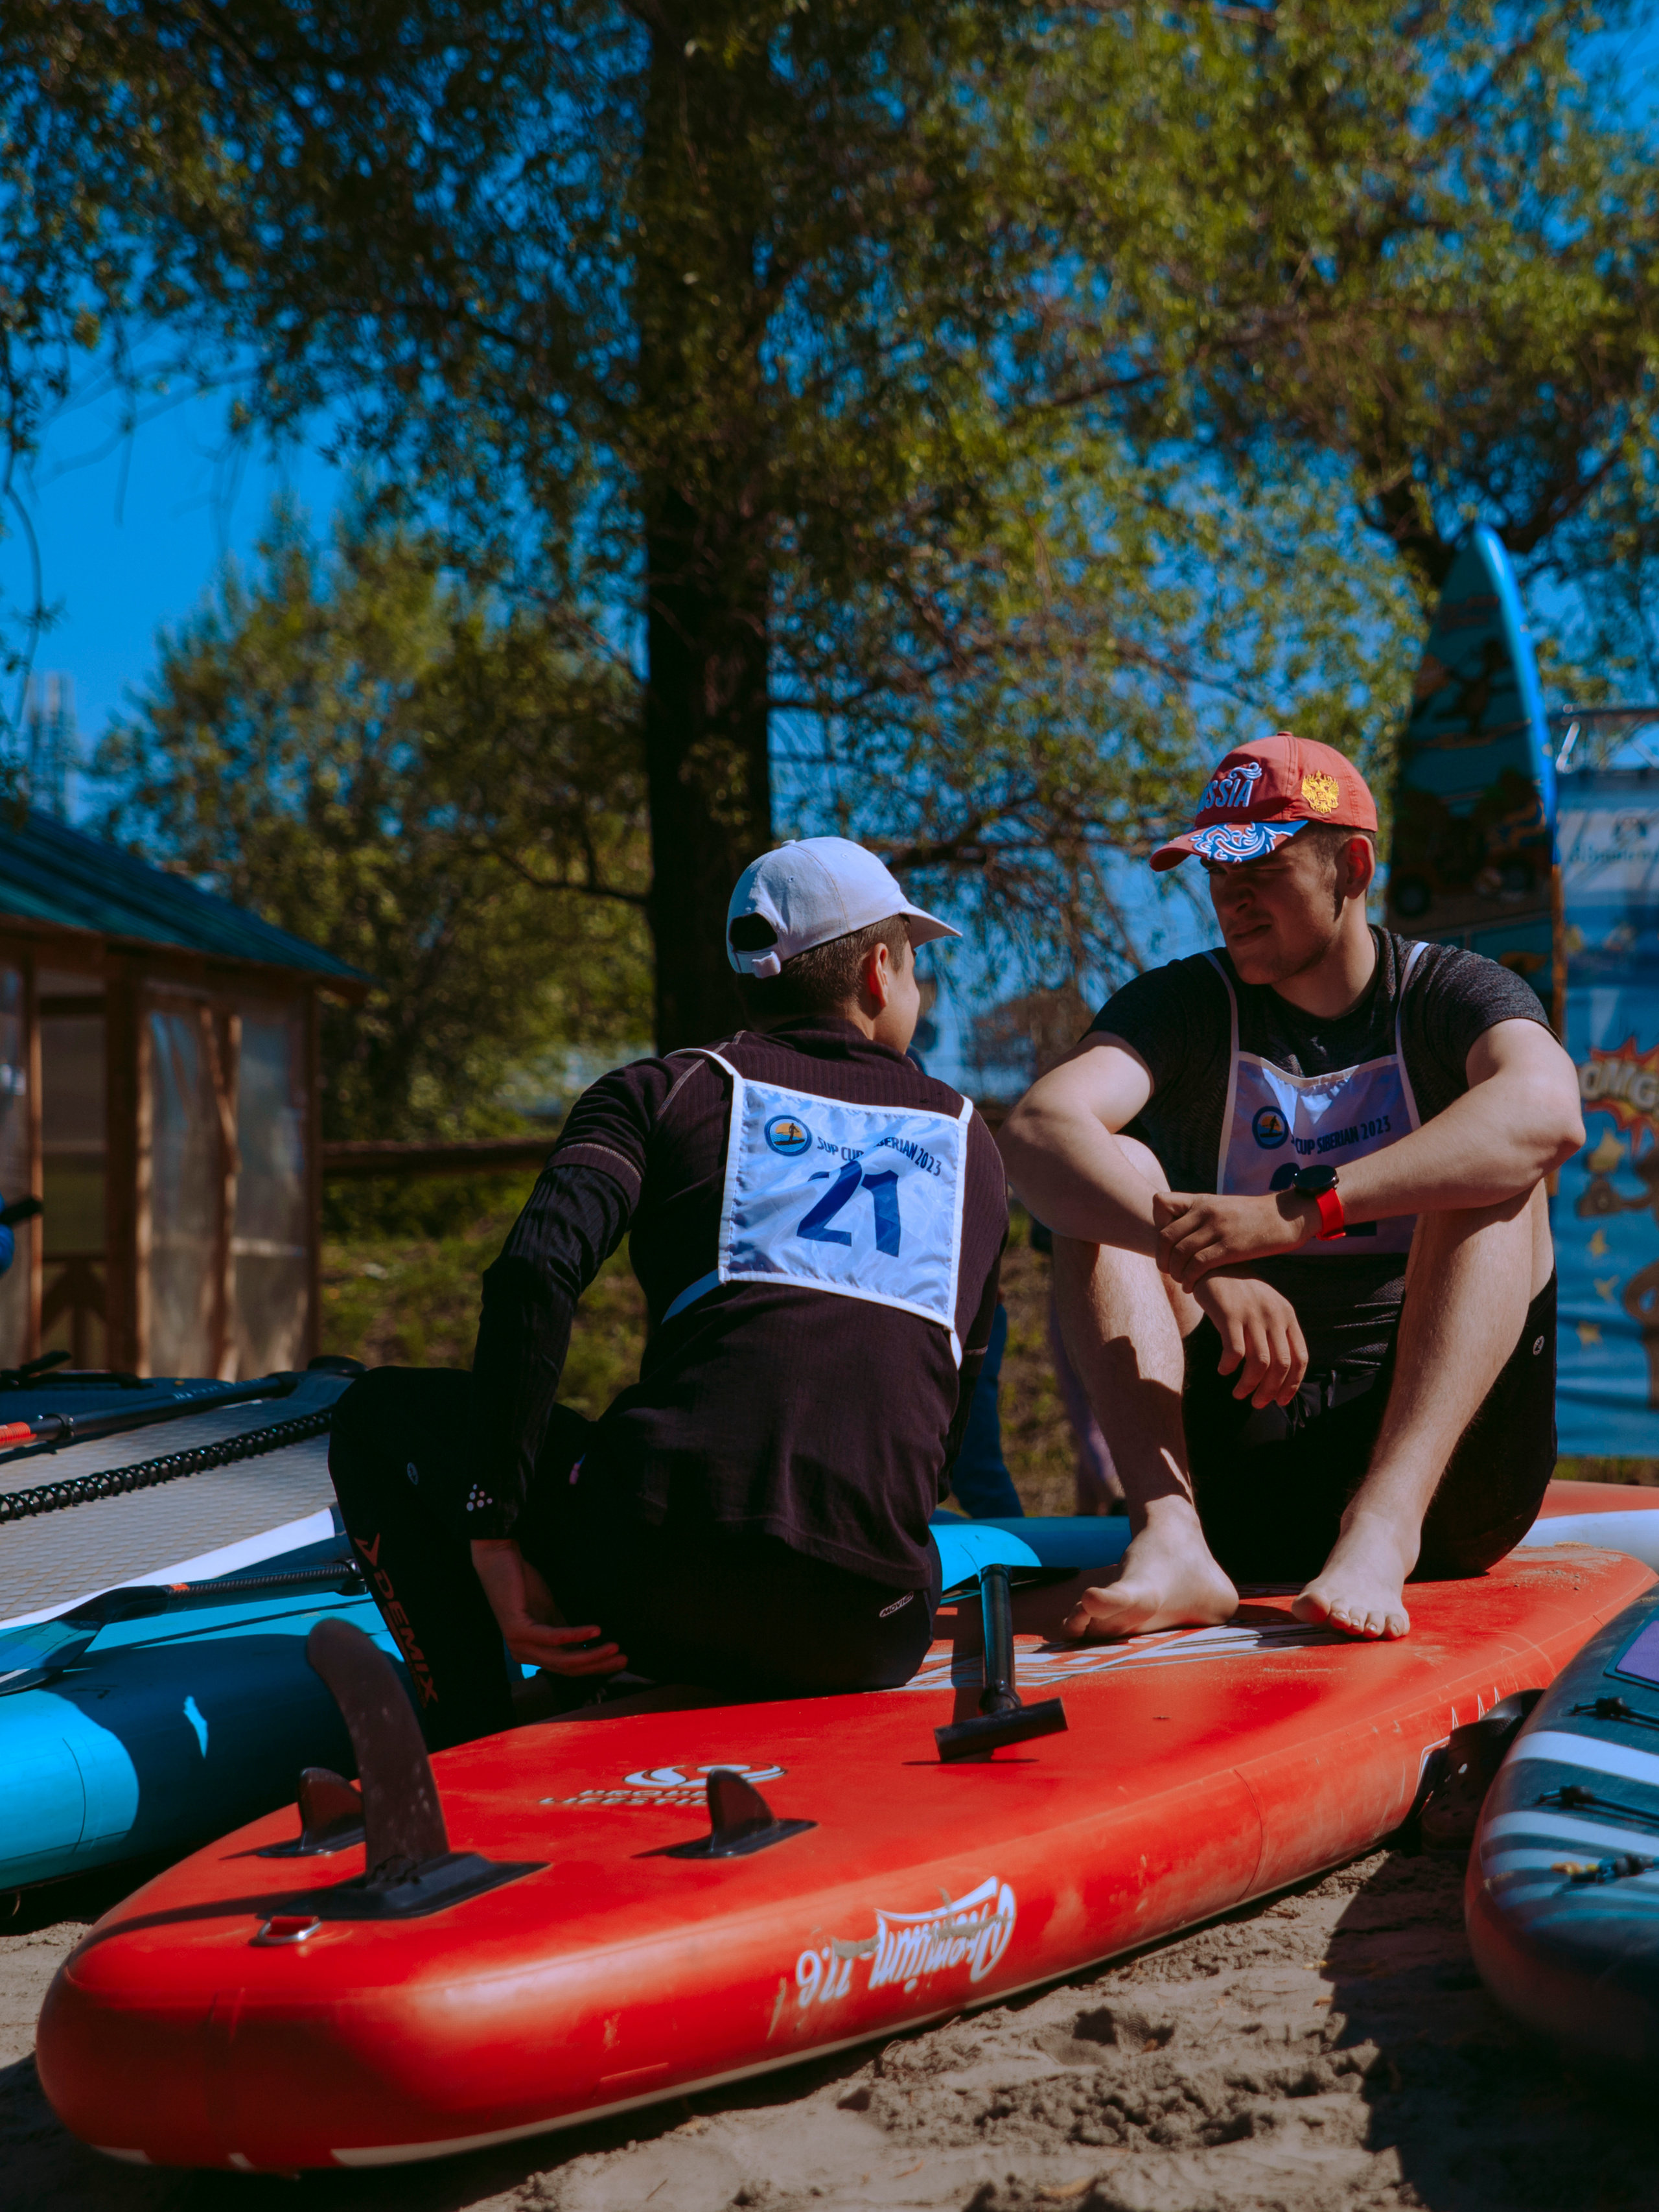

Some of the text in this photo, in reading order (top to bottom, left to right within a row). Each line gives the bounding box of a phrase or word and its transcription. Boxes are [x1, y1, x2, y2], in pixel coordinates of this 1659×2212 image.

[1196, 778, 1254, 813] SSIA
[1295, 1115, 1391, 1156] CUP SIBERIAN 2023
[817, 1136, 839, 1156] SUP
[874, 1136, 919, 1161] BERIAN
[914, 1147, 942, 1177] 2023
[796, 1159, 901, 1258] 21
[373, 1568, 439, 1703] DEMIX
